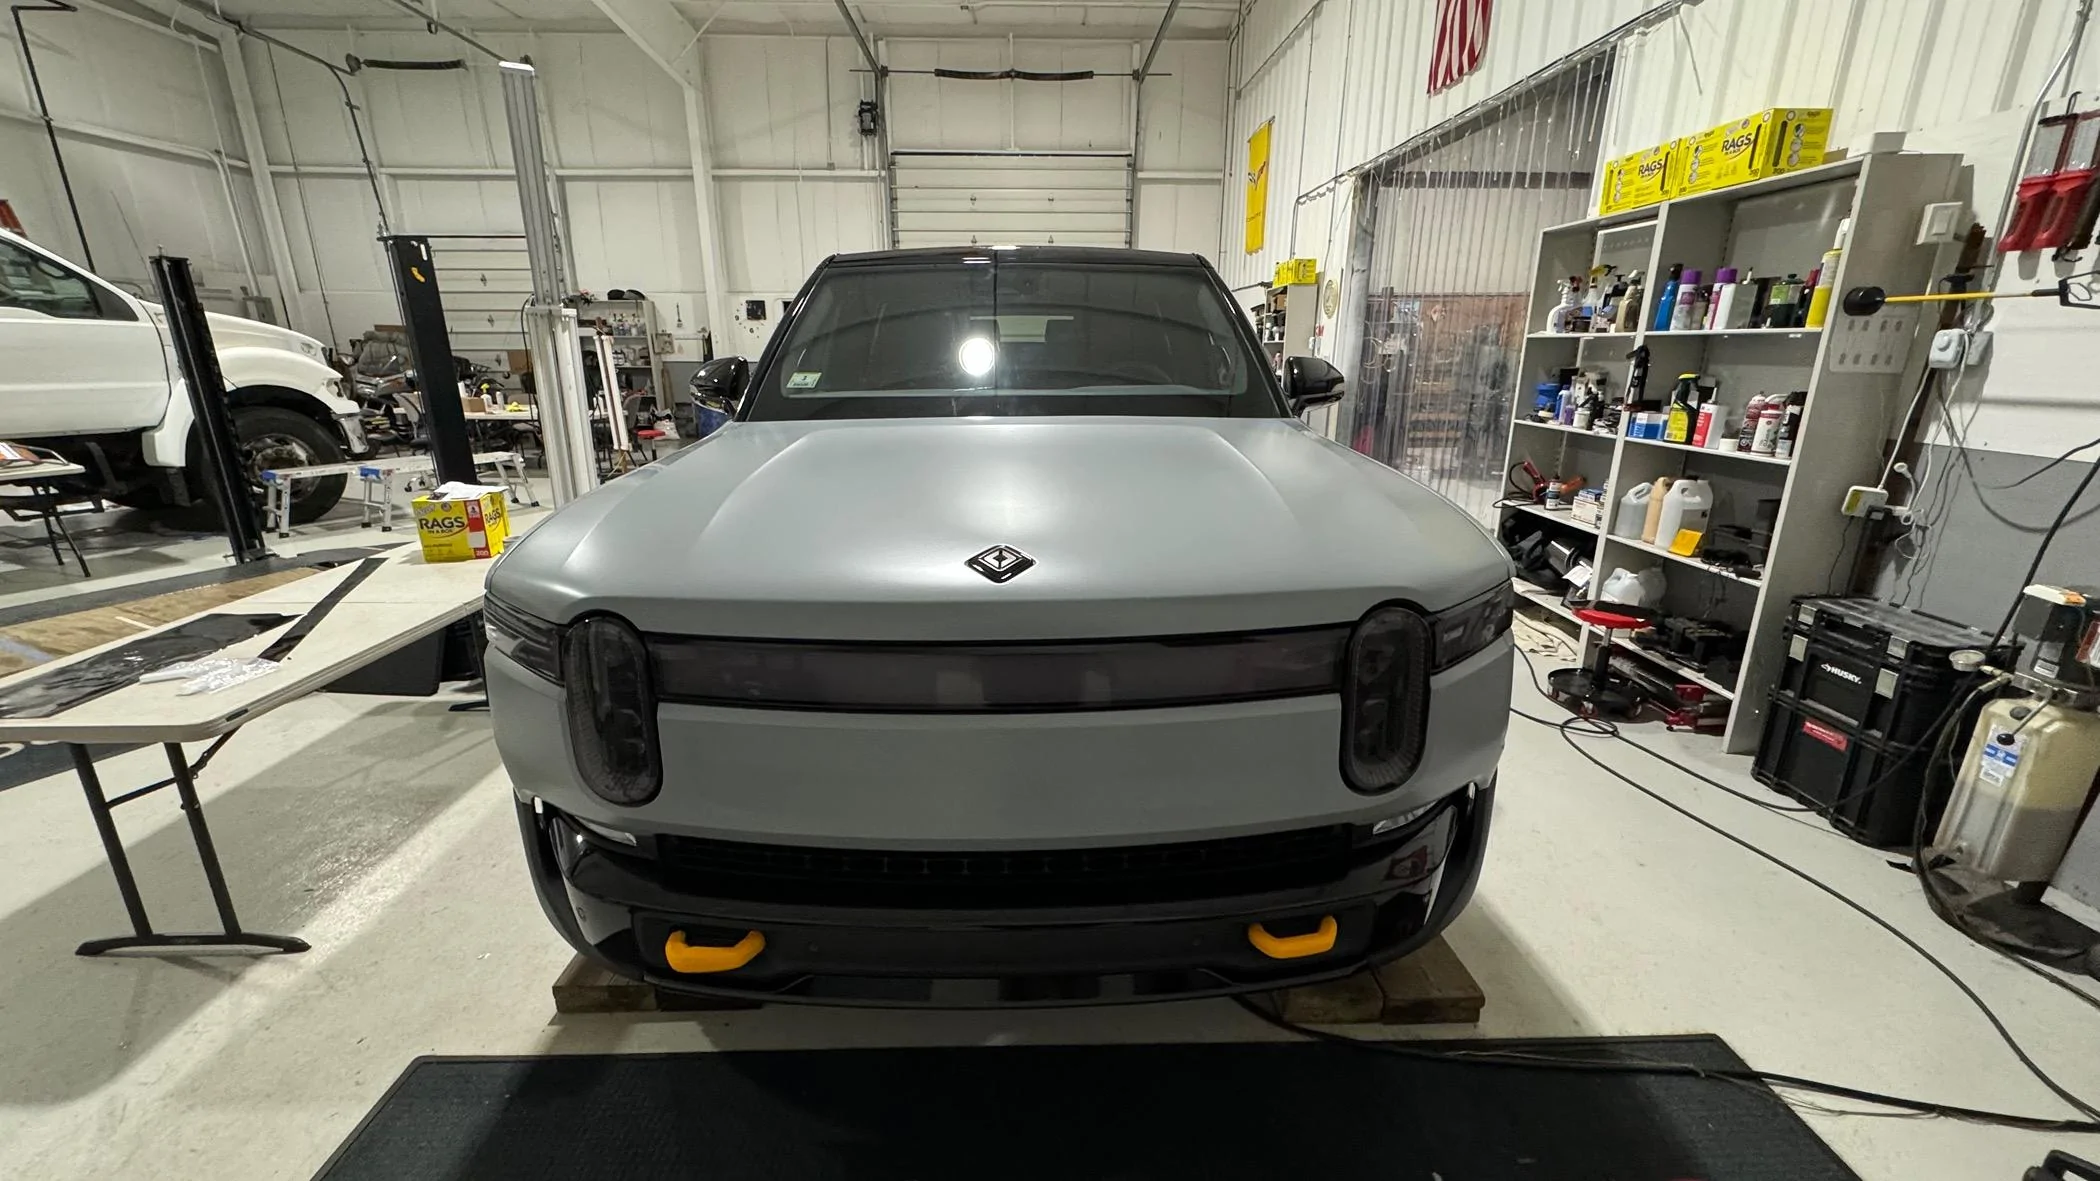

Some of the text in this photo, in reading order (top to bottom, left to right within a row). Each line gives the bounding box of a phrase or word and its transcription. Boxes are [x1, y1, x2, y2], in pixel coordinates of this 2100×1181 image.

[1721, 133, 1752, 152] RAGS
[1638, 159, 1663, 176] RAGS
[419, 516, 465, 529] RAGS
[485, 508, 501, 523] RAGS
[1830, 667, 1861, 683] HUSKY
